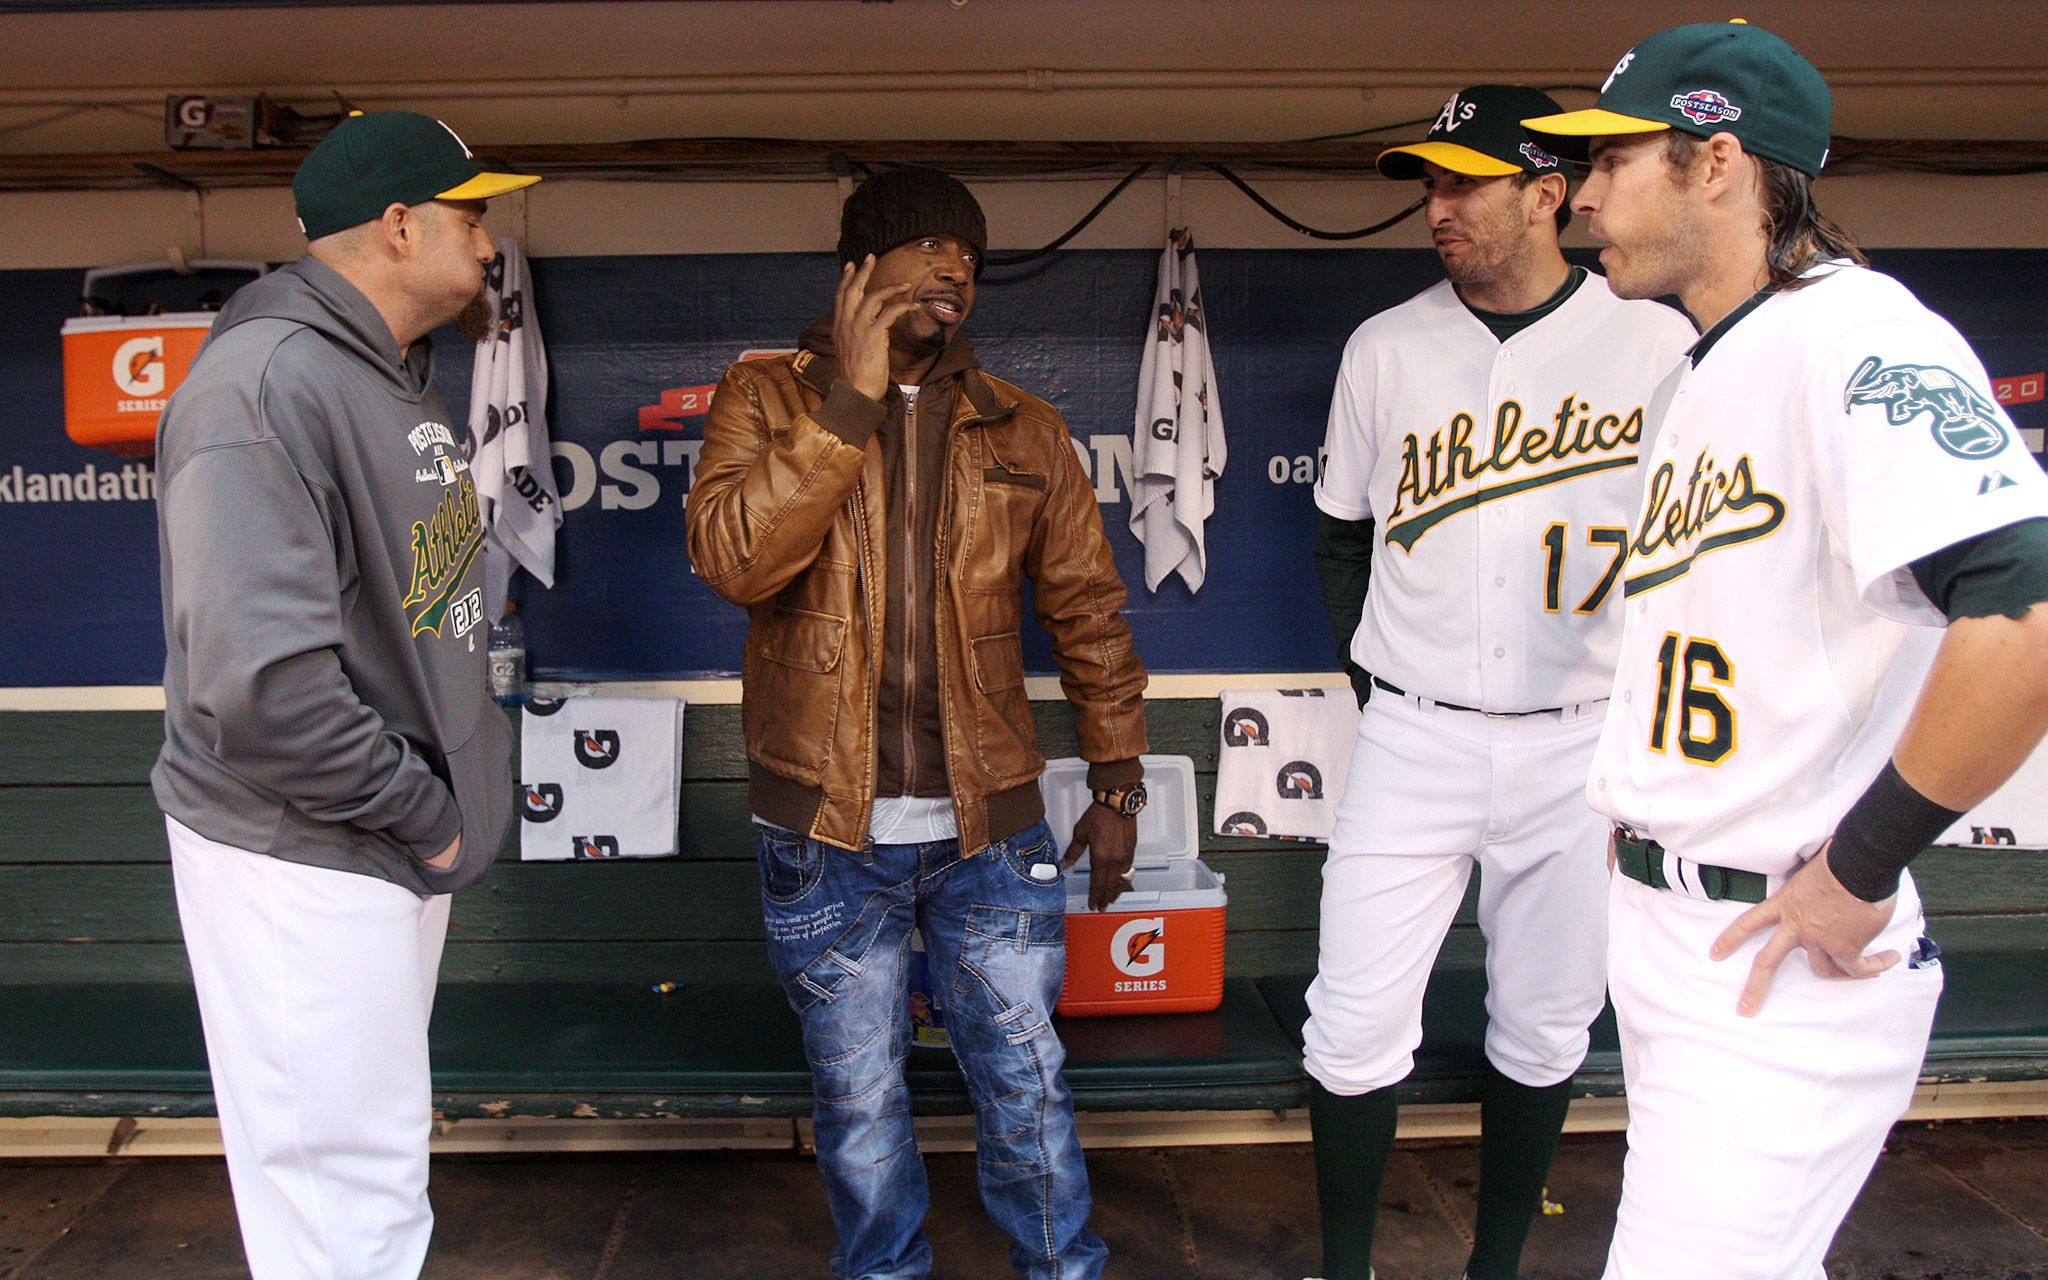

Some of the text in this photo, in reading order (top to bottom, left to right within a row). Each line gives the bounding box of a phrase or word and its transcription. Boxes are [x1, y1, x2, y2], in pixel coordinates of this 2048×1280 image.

[180, 99, 206, 128] G
[1429, 93, 1476, 135] A's
[1673, 98, 1738, 119] POSTSEASON
[112, 336, 165, 397] G
[117, 399, 168, 412] SERIES
[1998, 378, 2038, 400] 20
[1386, 389, 1645, 525] Athletics
[1541, 521, 1629, 615] 17
[493, 662, 515, 676] G2
[1648, 630, 1739, 768] 16
[1224, 707, 1270, 747] G
[573, 729, 621, 769] G
[1276, 760, 1324, 800] G
[1110, 917, 1165, 977] G
[1114, 979, 1168, 993] SERIES
